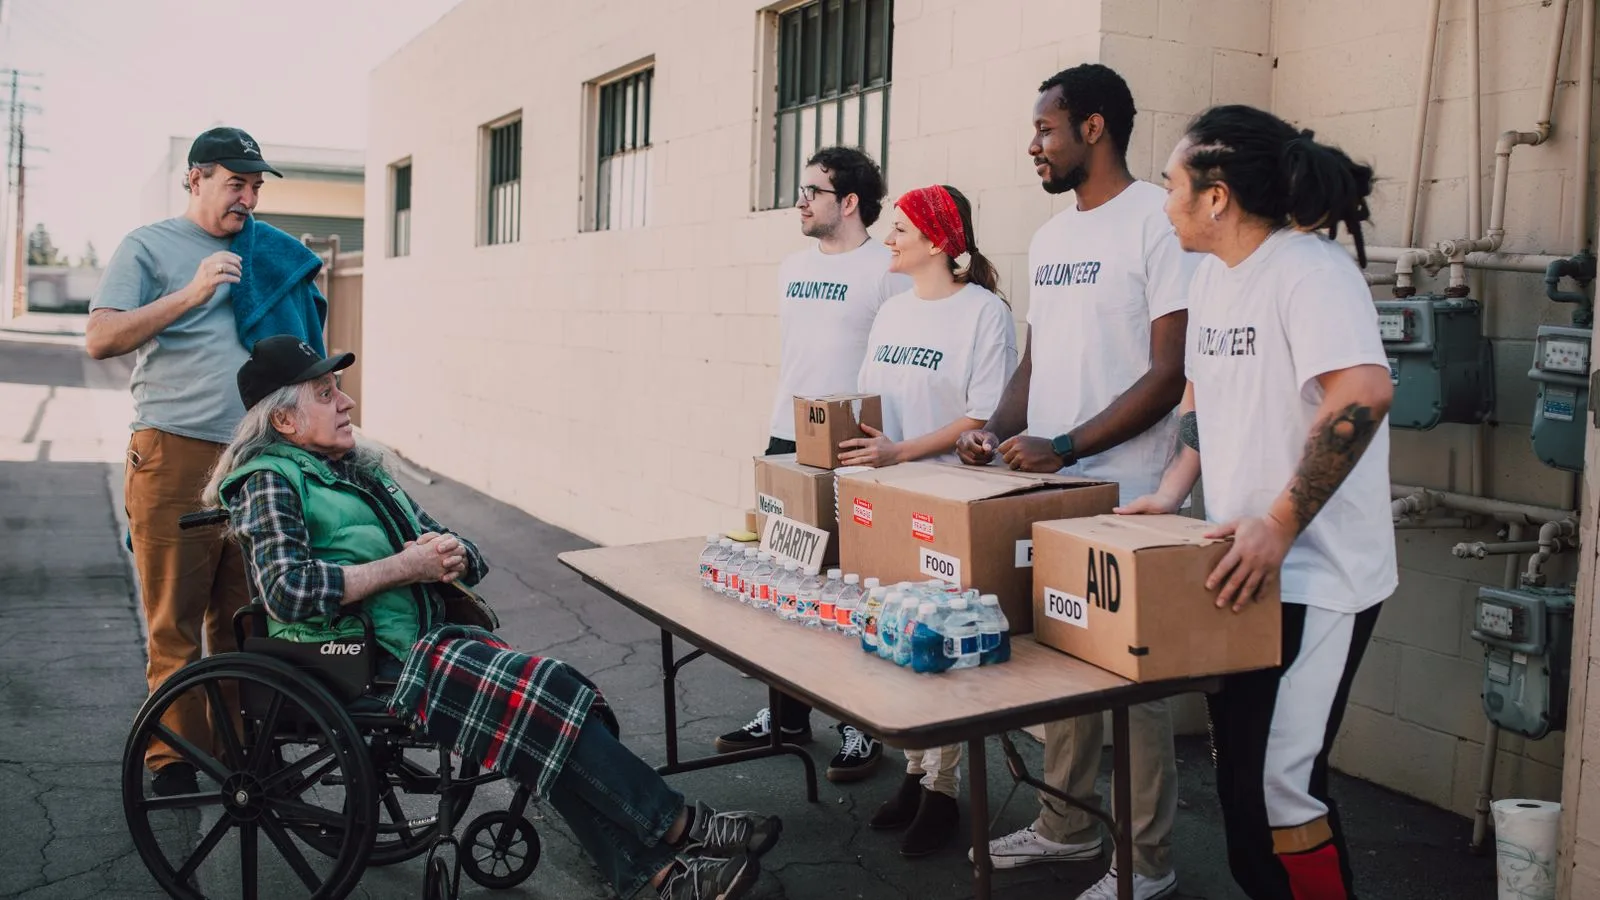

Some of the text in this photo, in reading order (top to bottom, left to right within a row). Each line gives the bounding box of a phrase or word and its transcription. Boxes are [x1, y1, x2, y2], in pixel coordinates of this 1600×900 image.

[1034, 261, 1101, 286] VOLUNTEER
[786, 281, 848, 301] VOLUNTEER
[873, 344, 943, 371] VOLUNTEER
[808, 406, 826, 425] AID
[769, 519, 821, 566] CHARITY
[925, 554, 954, 577] FOOD
[1086, 547, 1121, 613] AID
[1049, 594, 1083, 620] FOOD
[320, 641, 361, 655] drive
